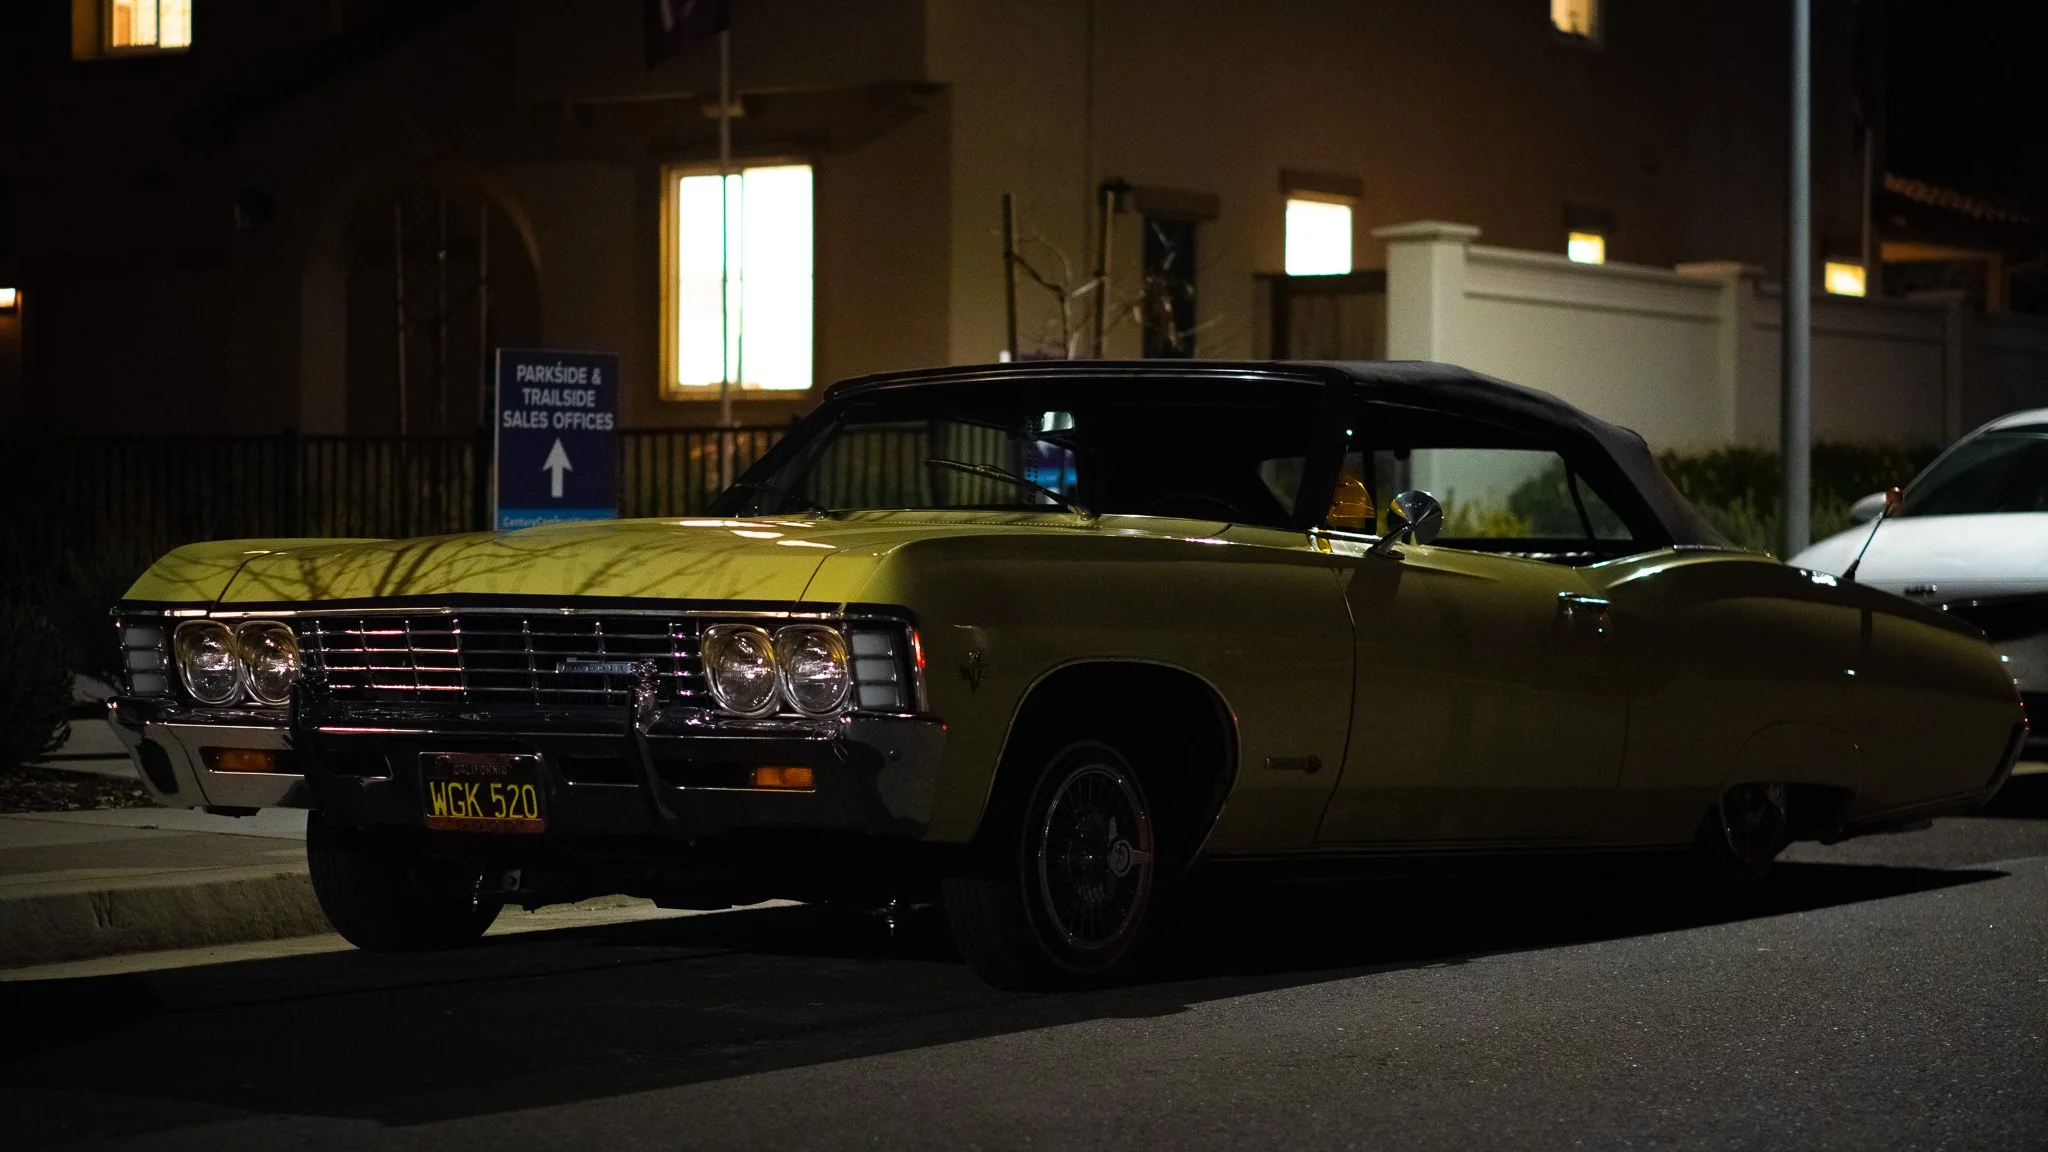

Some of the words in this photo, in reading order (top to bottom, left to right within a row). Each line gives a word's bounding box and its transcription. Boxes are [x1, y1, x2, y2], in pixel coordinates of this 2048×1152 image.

[517, 364, 588, 384] PARKSIDE
[592, 367, 603, 385] &
[522, 387, 596, 408] TRAILSIDE
[503, 410, 549, 429] SALES
[553, 412, 614, 431] OFFICES
[453, 764, 507, 776] CALIFORNIA
[429, 781, 483, 817] WGK
[490, 783, 538, 819] 520
